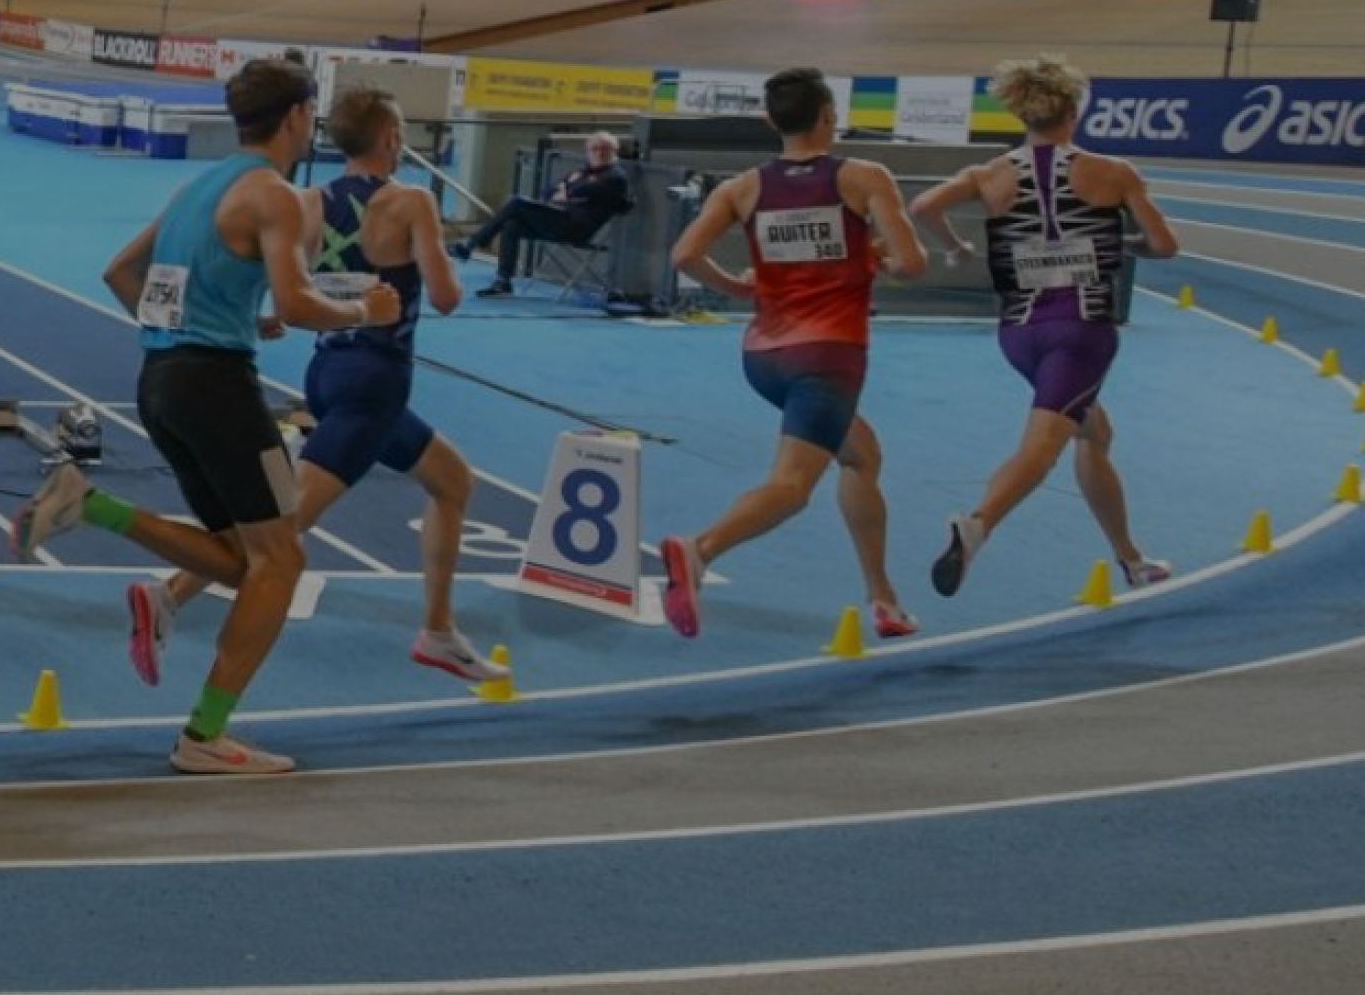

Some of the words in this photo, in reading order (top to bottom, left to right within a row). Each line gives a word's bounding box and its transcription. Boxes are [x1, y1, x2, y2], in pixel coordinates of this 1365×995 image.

[1084, 98, 1188, 140] asics
[767, 223, 832, 243] RUITER
[552, 468, 621, 566] 8
